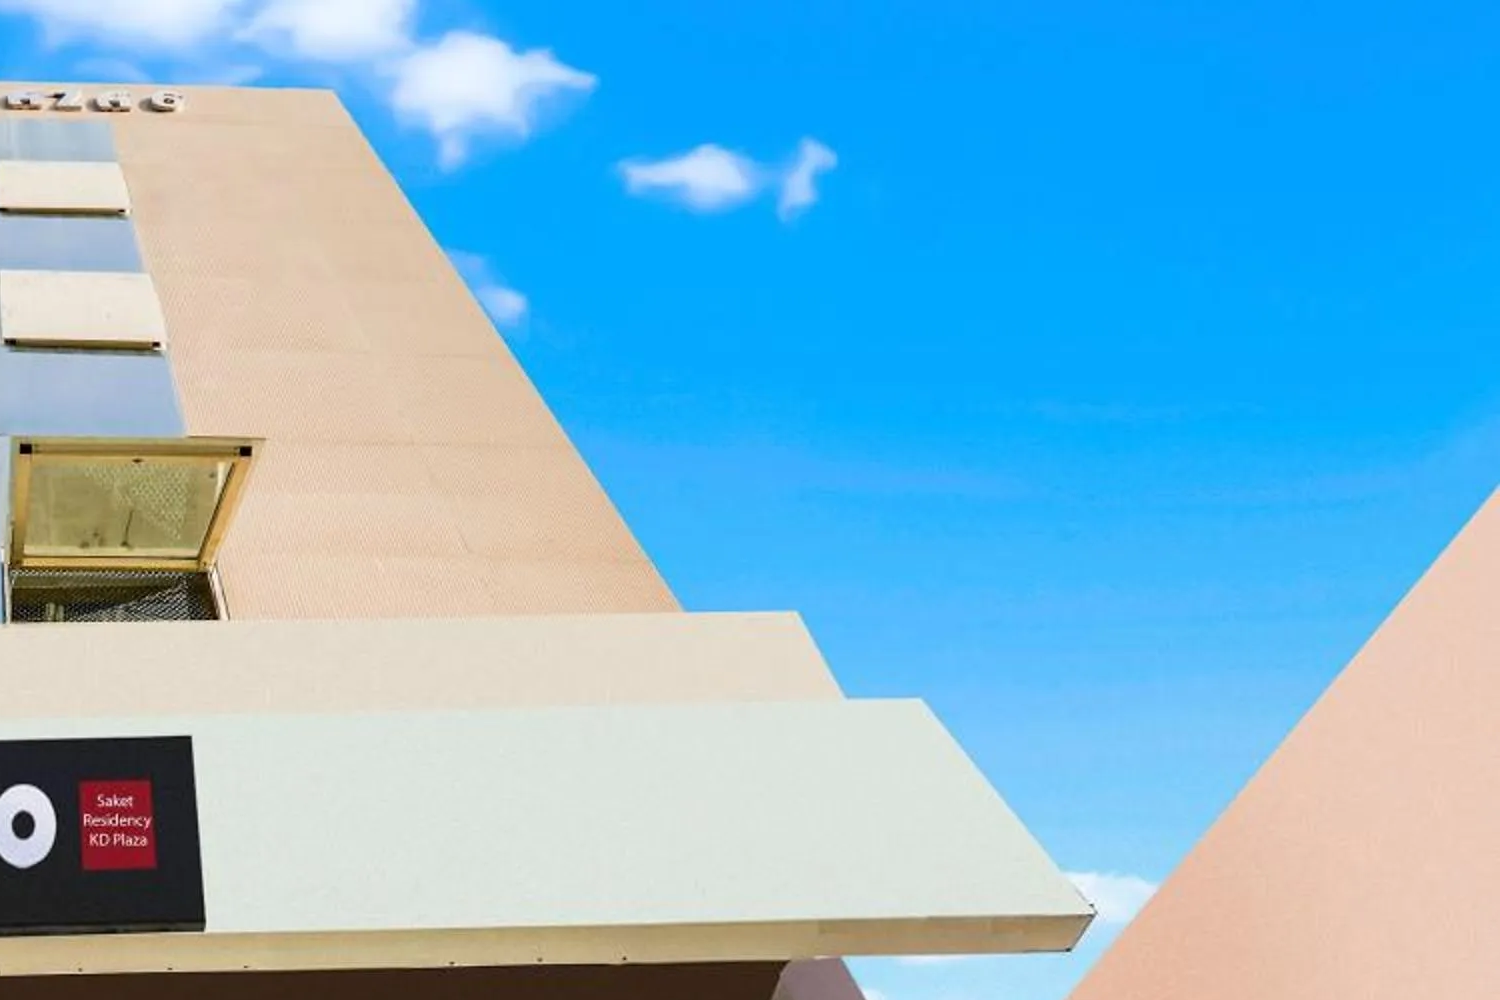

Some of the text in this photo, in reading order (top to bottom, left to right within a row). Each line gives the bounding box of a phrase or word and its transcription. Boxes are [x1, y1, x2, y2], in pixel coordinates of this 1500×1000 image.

[96, 793, 134, 808] Saket
[83, 813, 152, 830] Residency
[88, 833, 149, 847] KD Plaza
